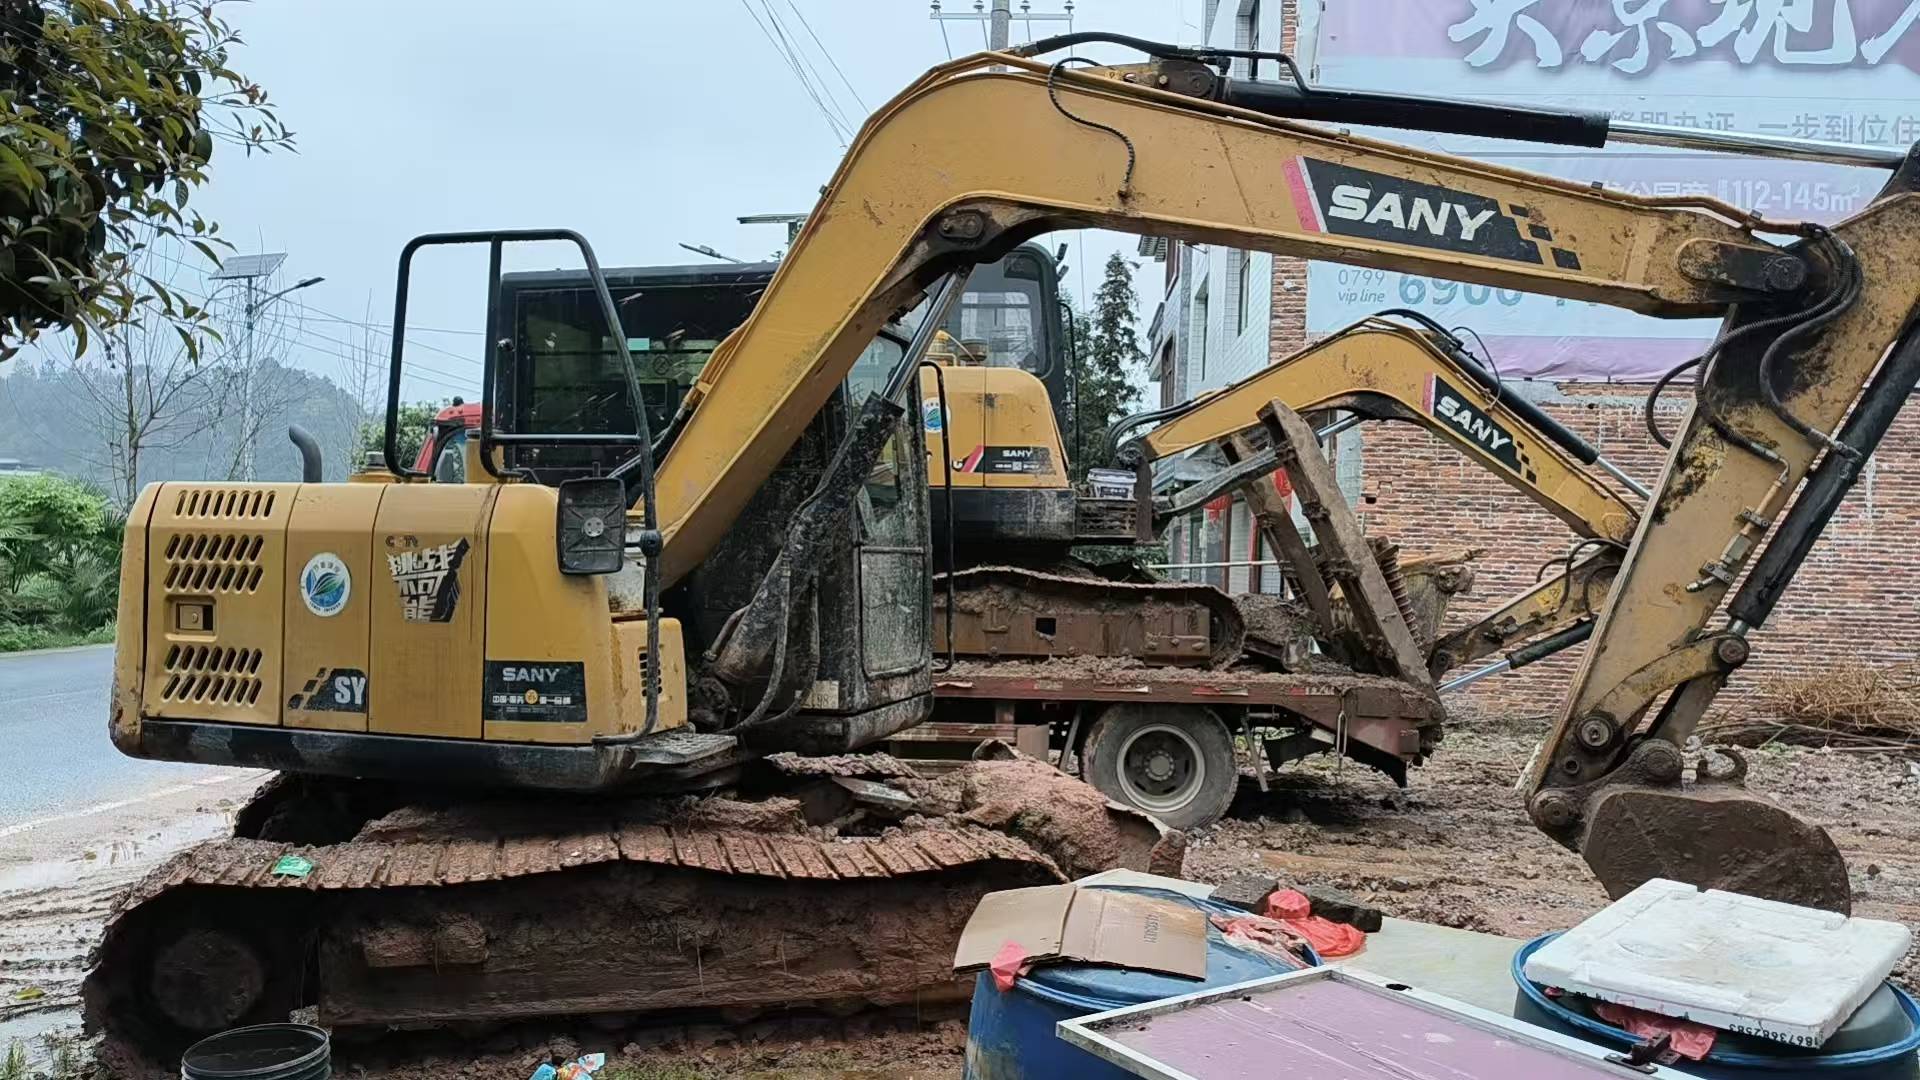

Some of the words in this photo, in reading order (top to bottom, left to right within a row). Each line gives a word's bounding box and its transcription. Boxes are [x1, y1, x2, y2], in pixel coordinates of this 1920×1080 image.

[1328, 184, 1496, 241] SANY
[1338, 269, 1385, 286] 0799
[1338, 288, 1358, 304] vip
[1360, 288, 1385, 303] line
[1437, 395, 1511, 450] SANY
[1002, 449, 1033, 458] SANY
[502, 667, 560, 682] SANY
[334, 676, 366, 705] SY
